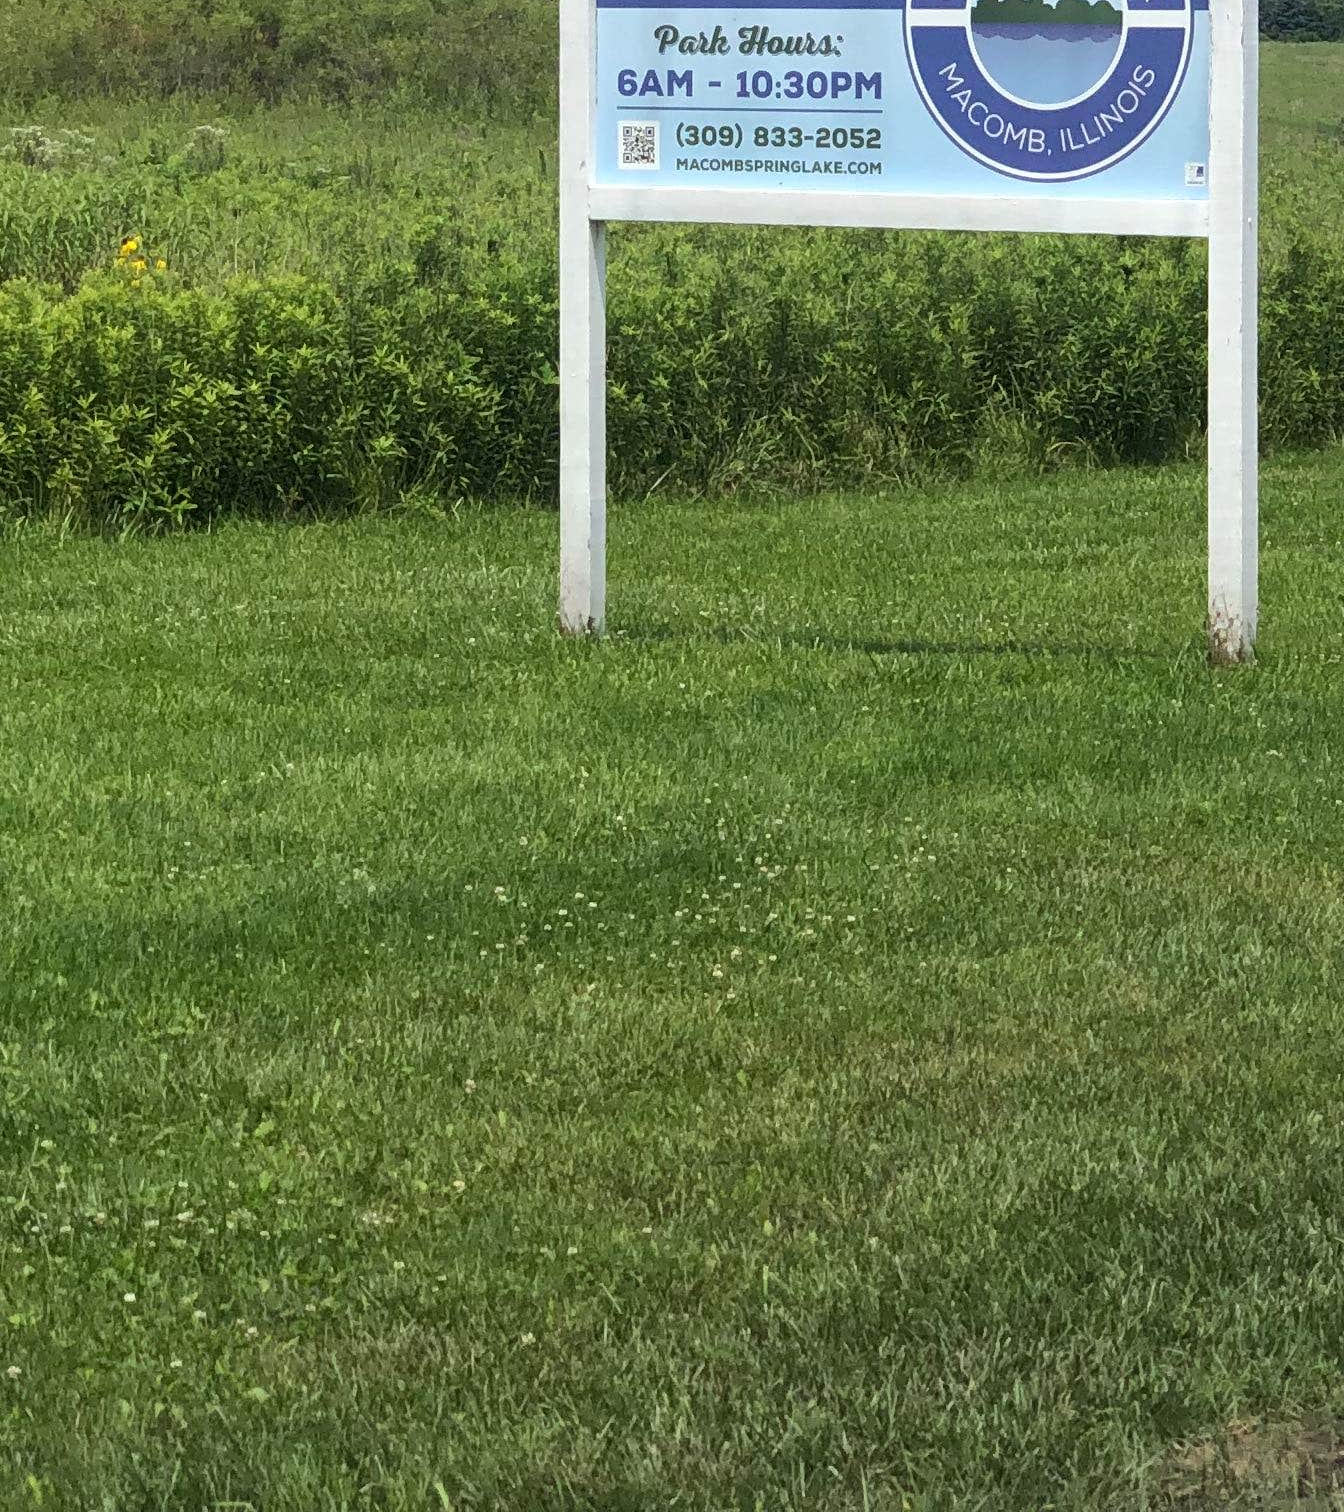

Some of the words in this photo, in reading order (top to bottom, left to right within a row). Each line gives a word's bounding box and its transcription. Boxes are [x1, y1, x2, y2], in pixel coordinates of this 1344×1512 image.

[654, 24, 731, 56] Park
[738, 25, 844, 56] Hours:
[617, 69, 693, 97] 6AM
[736, 70, 883, 99] 10:30PM
[939, 62, 1052, 156] MACOMB,
[1059, 64, 1156, 152] ILLINOIS
[676, 122, 743, 148] (309)
[754, 127, 882, 149] 833-2052
[676, 158, 882, 174] MACOMBSPRINGLAKE.COM
